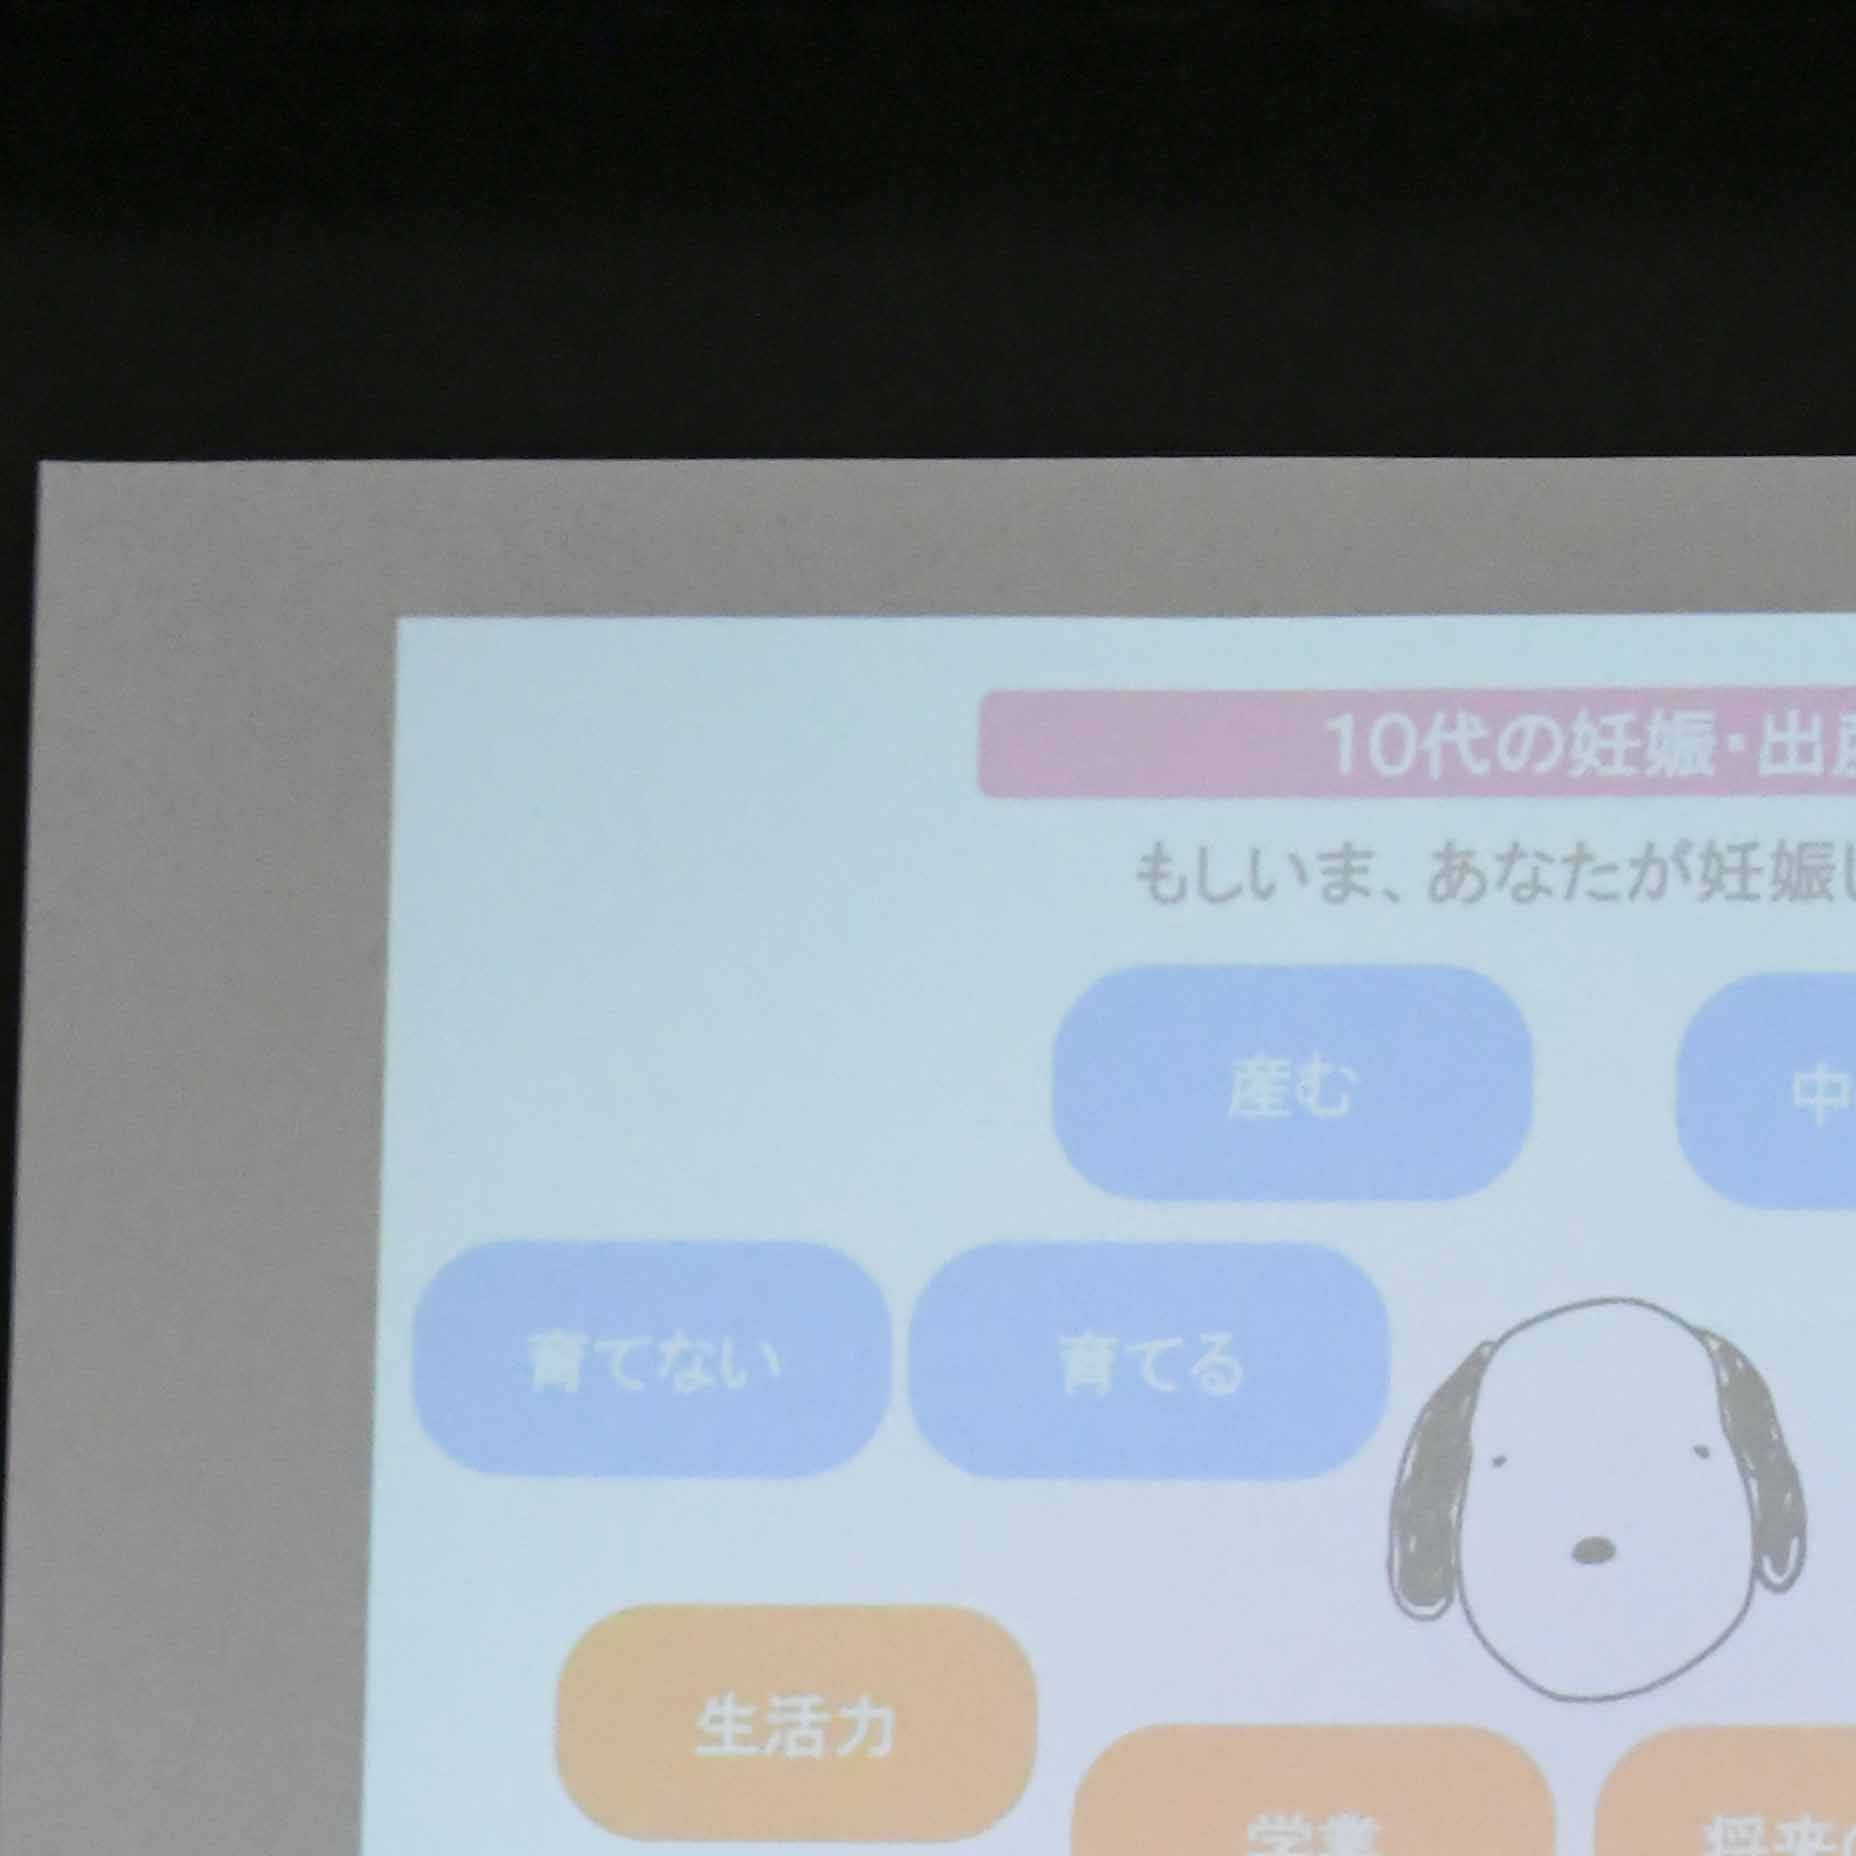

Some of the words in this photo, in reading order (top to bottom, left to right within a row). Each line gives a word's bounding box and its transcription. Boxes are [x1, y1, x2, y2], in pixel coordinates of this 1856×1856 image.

[1227, 1051, 1359, 1121] 産む
[527, 1329, 782, 1395] 育てない
[1058, 1329, 1244, 1397] 育てる
[694, 1691, 896, 1759] 生活力
